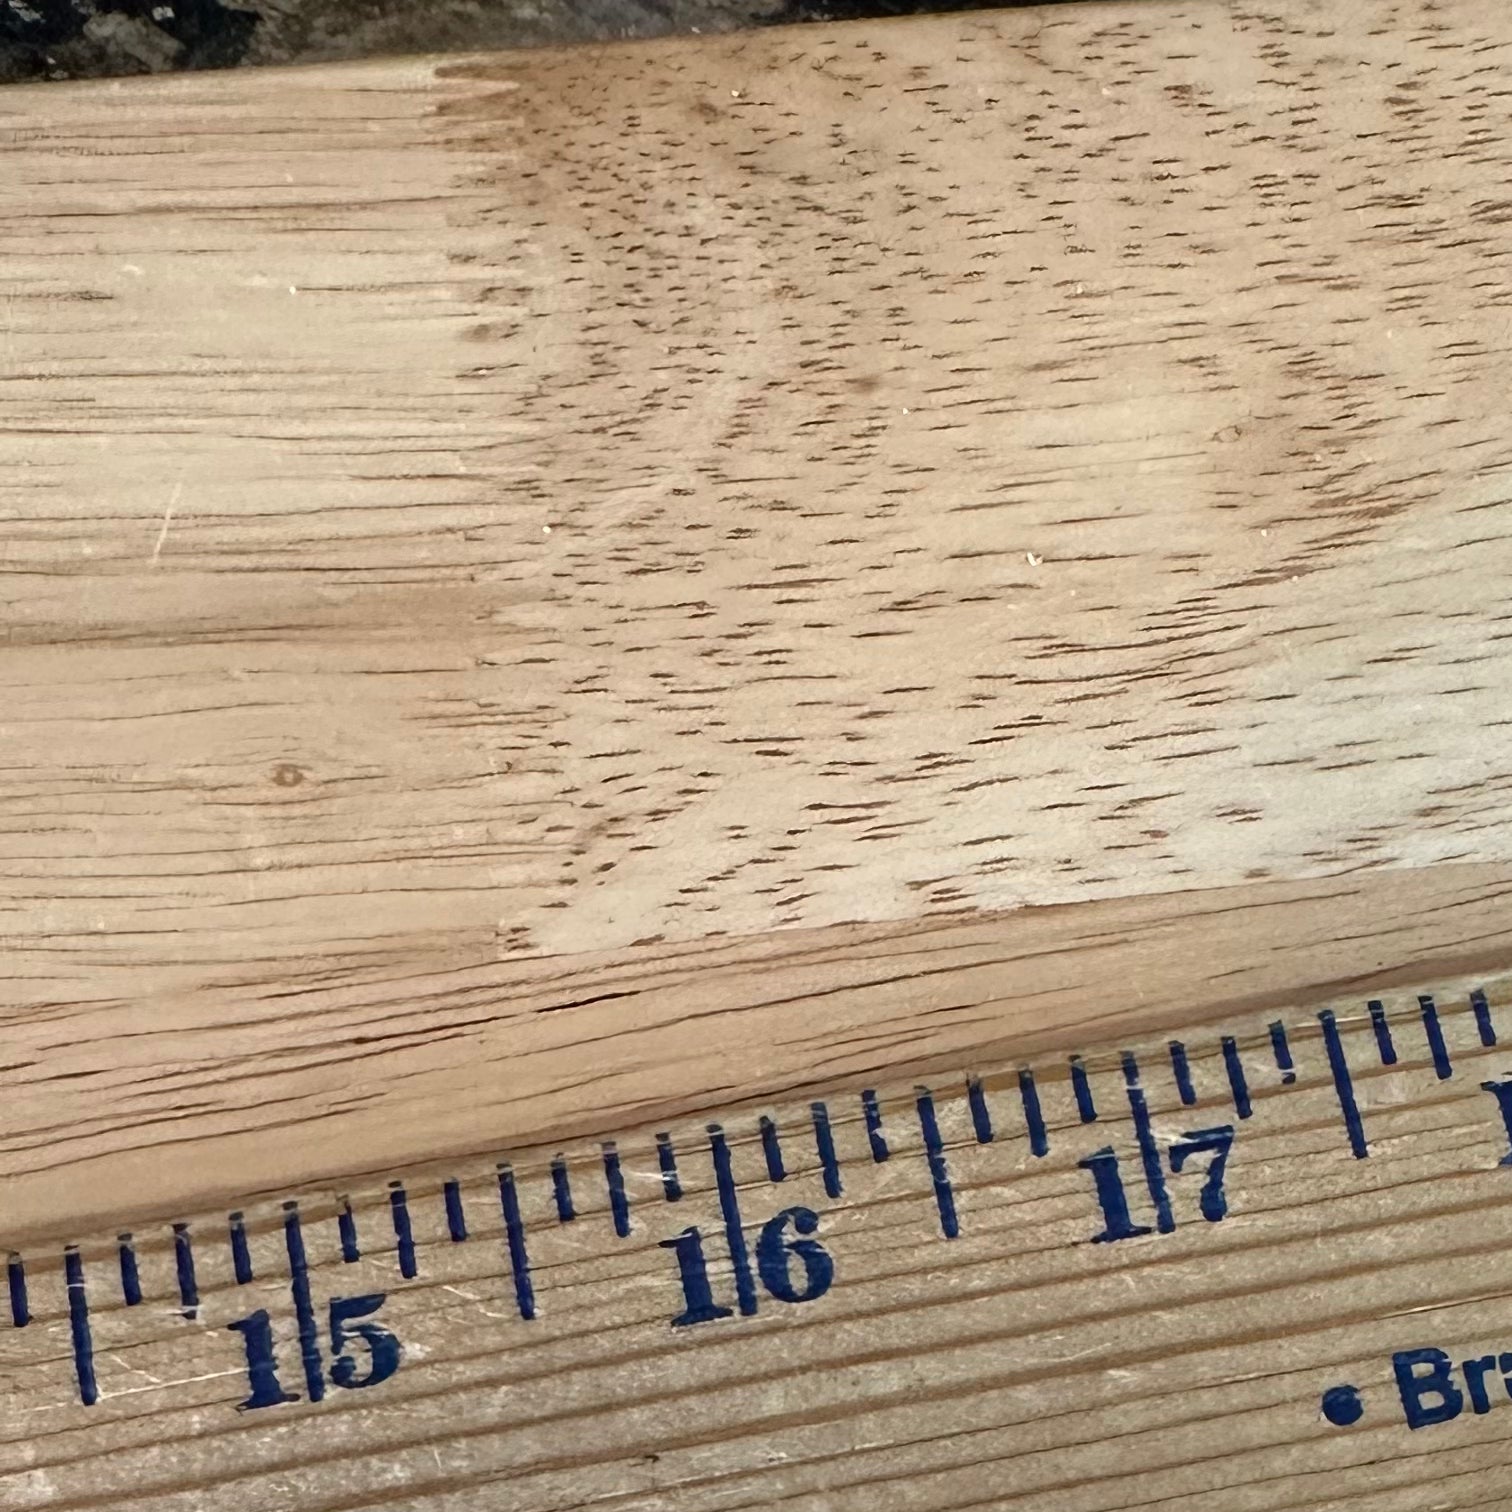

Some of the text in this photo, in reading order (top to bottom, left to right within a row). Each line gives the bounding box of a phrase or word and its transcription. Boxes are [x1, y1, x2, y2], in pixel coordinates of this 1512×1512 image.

[228, 1293, 401, 1412] 15
[658, 1206, 836, 1328] 16
[1077, 1124, 1235, 1243] 17
